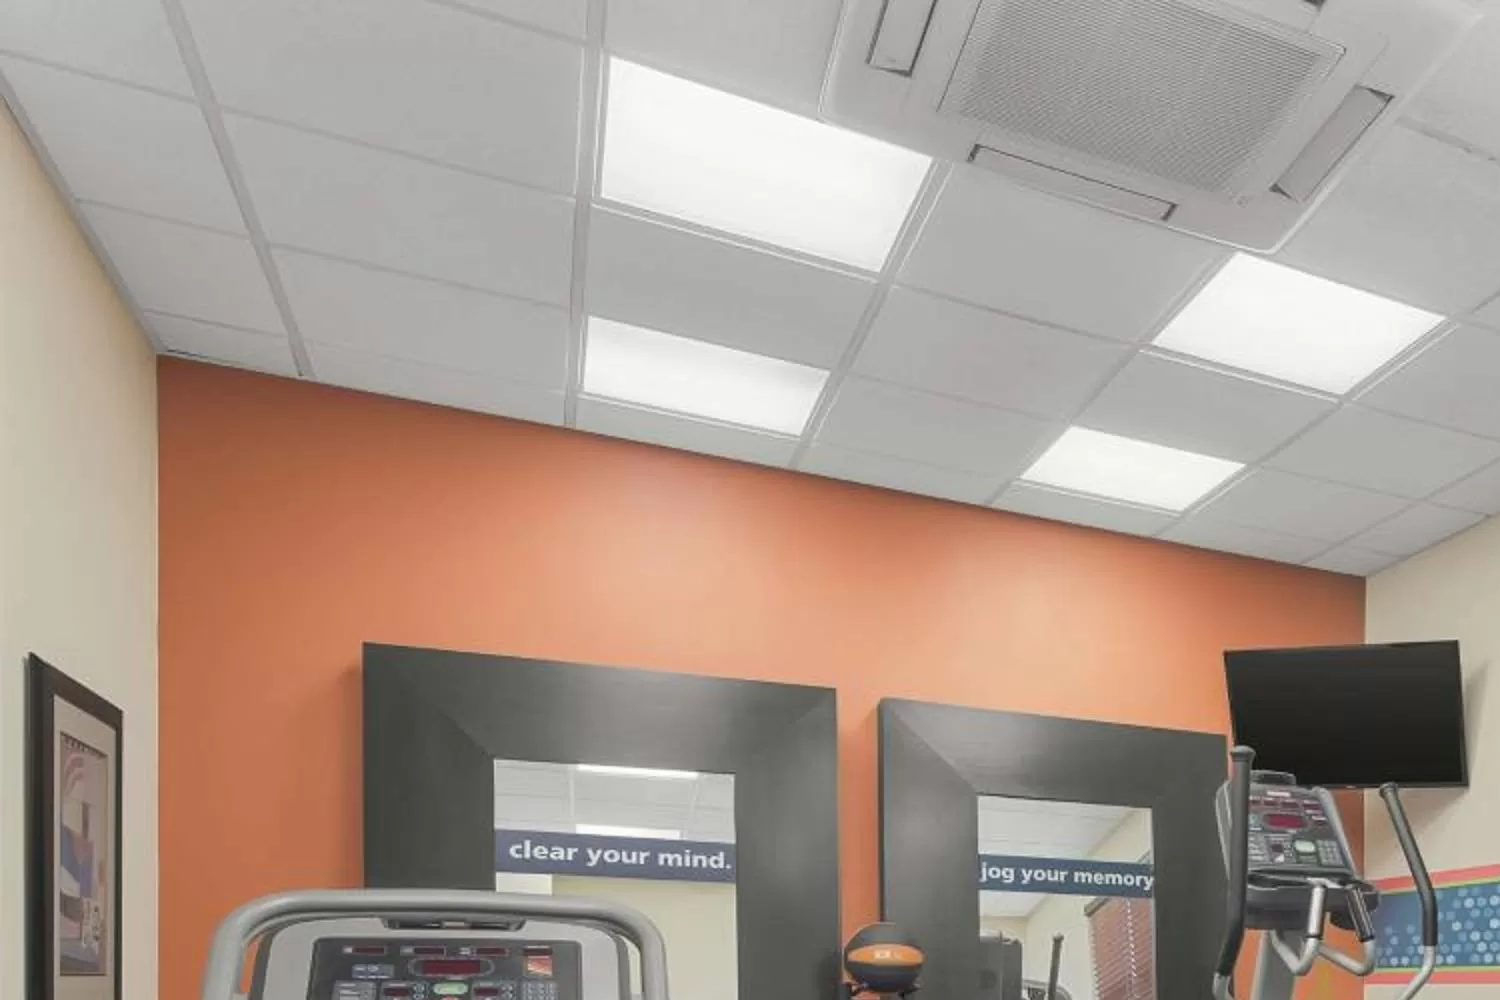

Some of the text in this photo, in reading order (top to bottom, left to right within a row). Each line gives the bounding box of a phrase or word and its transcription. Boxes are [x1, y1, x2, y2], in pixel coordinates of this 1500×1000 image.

[508, 839, 732, 870] clear your mind.
[979, 861, 1155, 891] jog your memory
